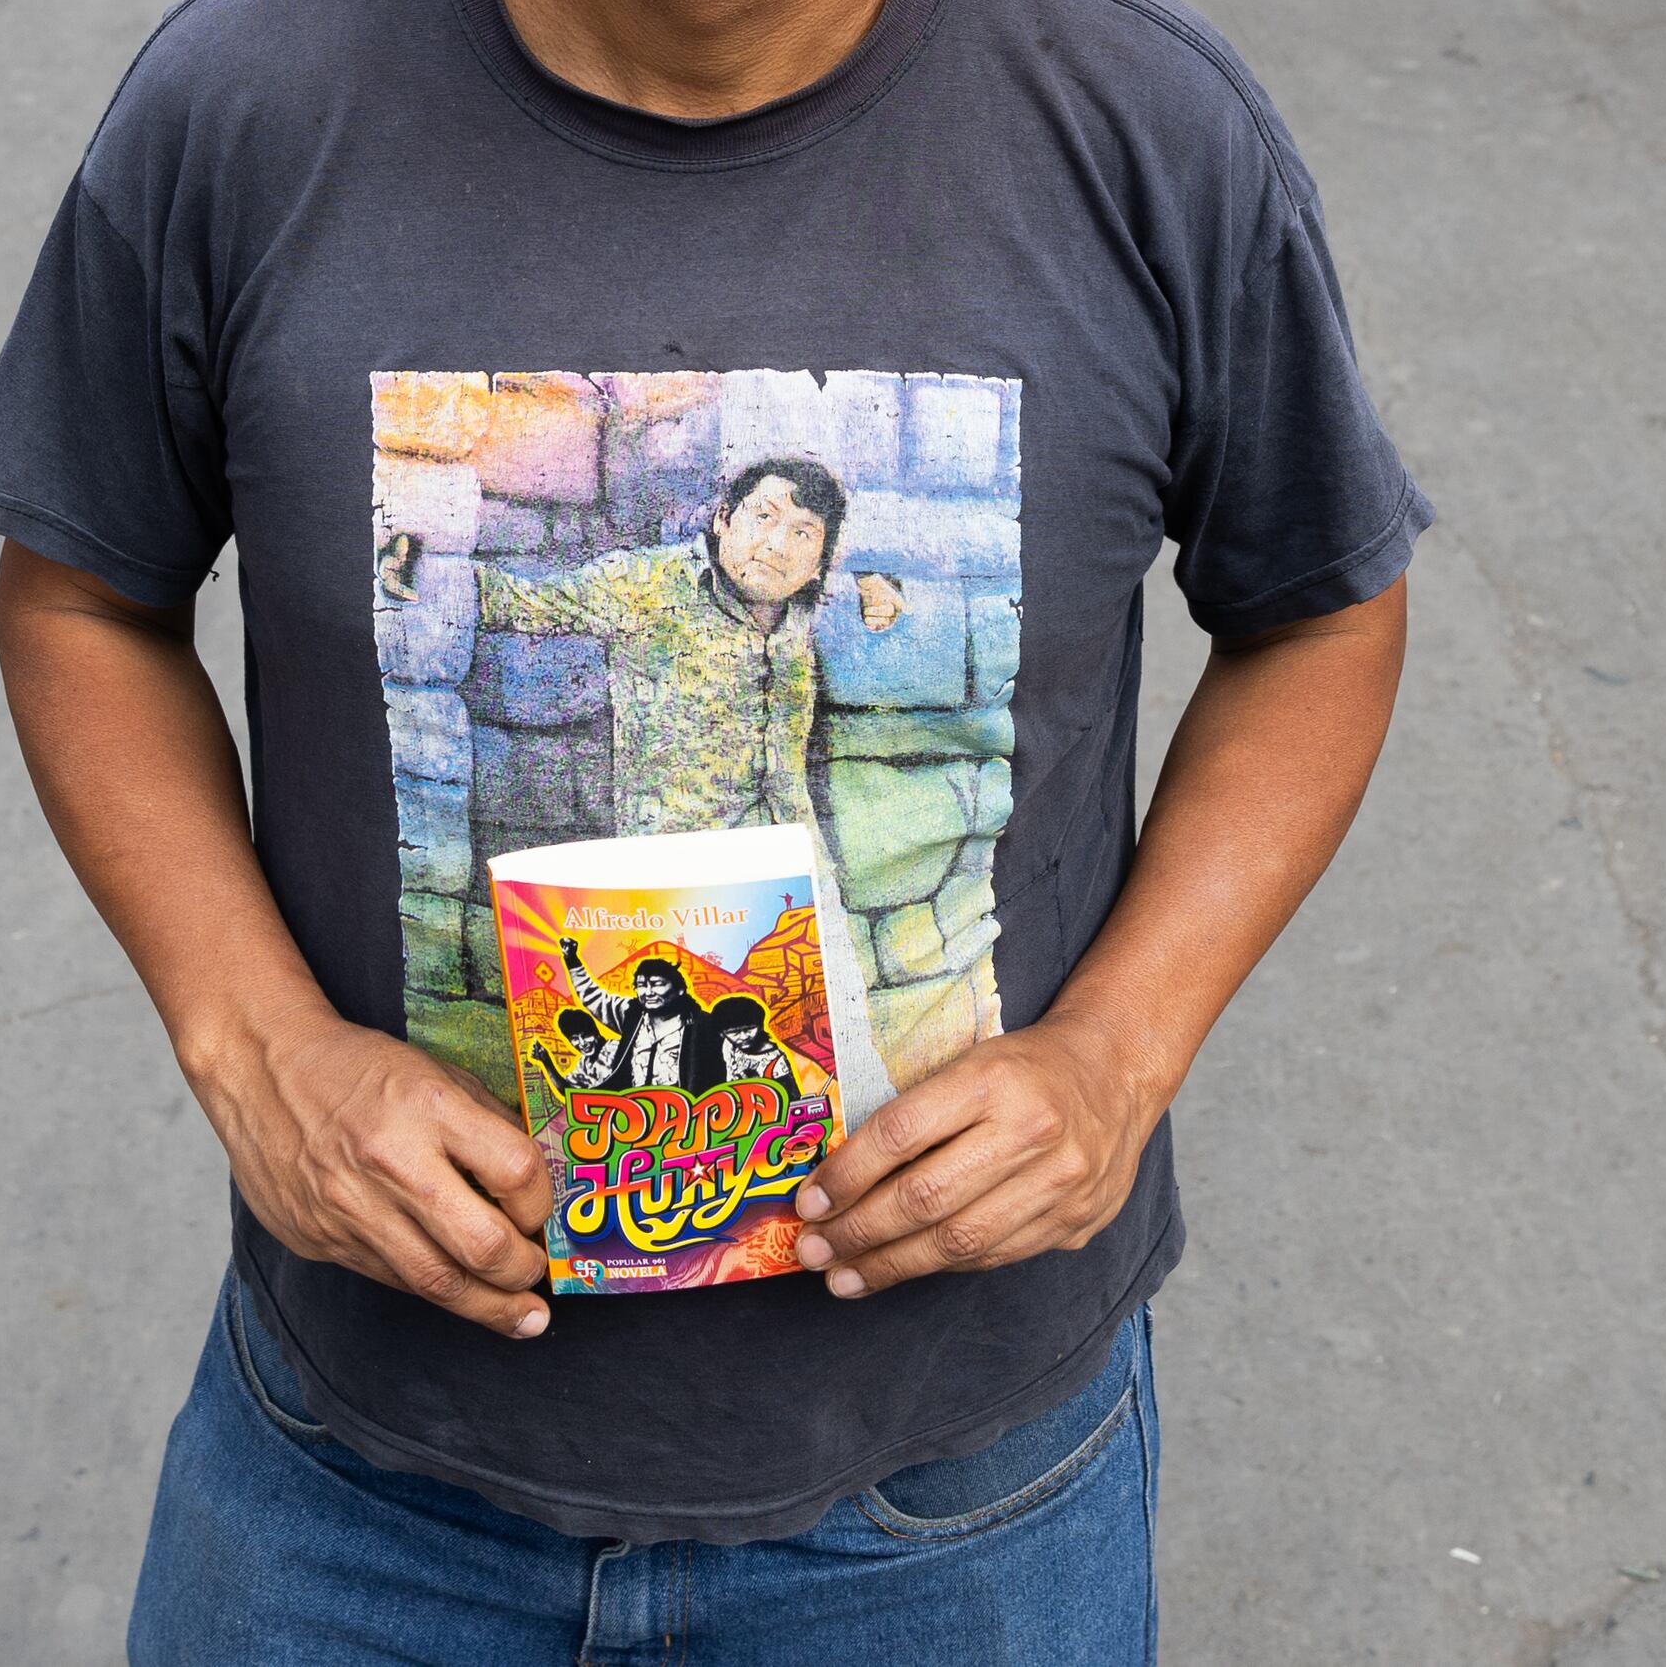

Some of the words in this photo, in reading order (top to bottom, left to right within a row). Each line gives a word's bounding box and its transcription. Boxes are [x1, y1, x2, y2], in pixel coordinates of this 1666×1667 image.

[565, 907, 664, 929] Alfredo
[670, 906, 749, 927] Villar
[568, 1083, 780, 1160] PAPA
[606, 1258, 649, 1266] POPULAR
[608, 1266, 668, 1279] NOVELA
